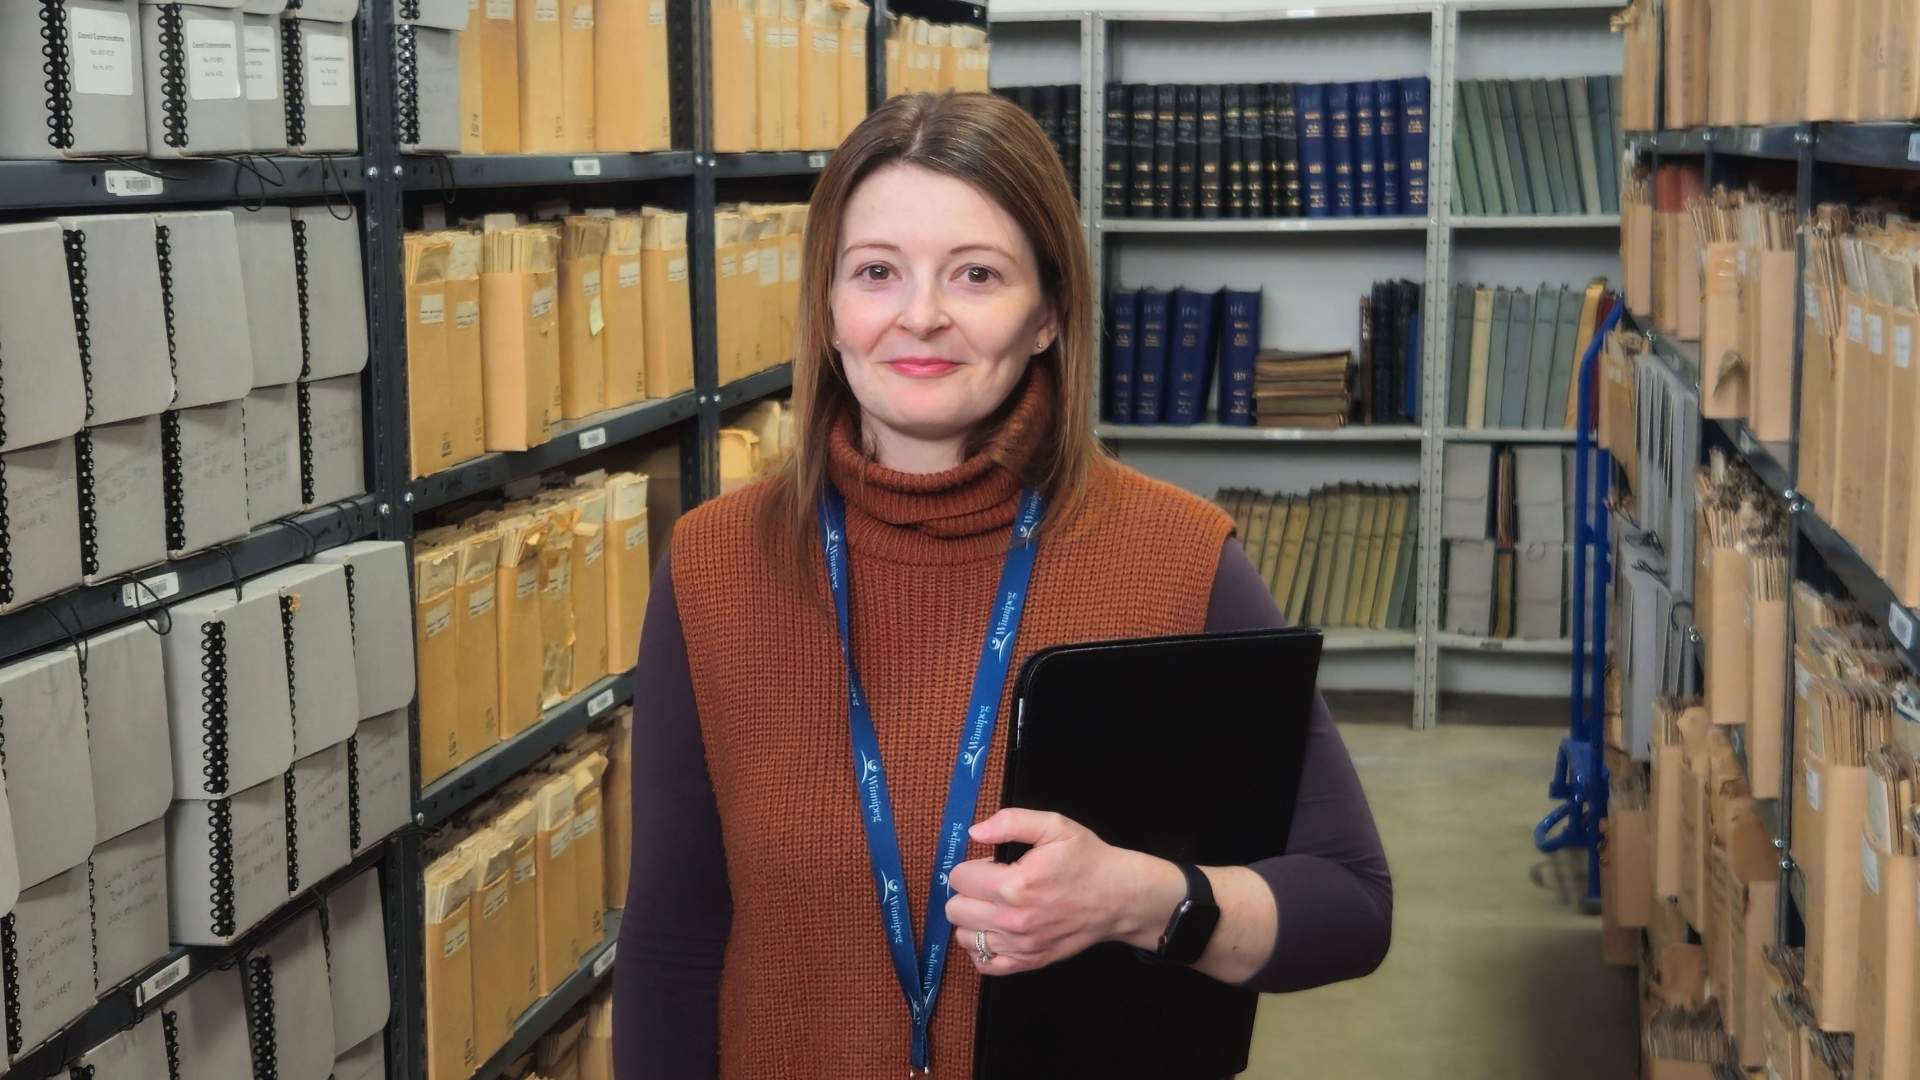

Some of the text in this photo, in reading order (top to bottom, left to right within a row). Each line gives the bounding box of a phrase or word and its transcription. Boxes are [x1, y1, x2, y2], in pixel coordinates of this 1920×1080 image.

[829, 544, 839, 591] Winnipeg
[995, 591, 1018, 635] Winnipeg
[967, 705, 991, 750] Winnipeg
[867, 775, 882, 823] Winnipeg
[942, 822, 963, 870] Winnipeg
[889, 895, 904, 944] Winnipeg
[923, 944, 940, 989] Winnipeg
